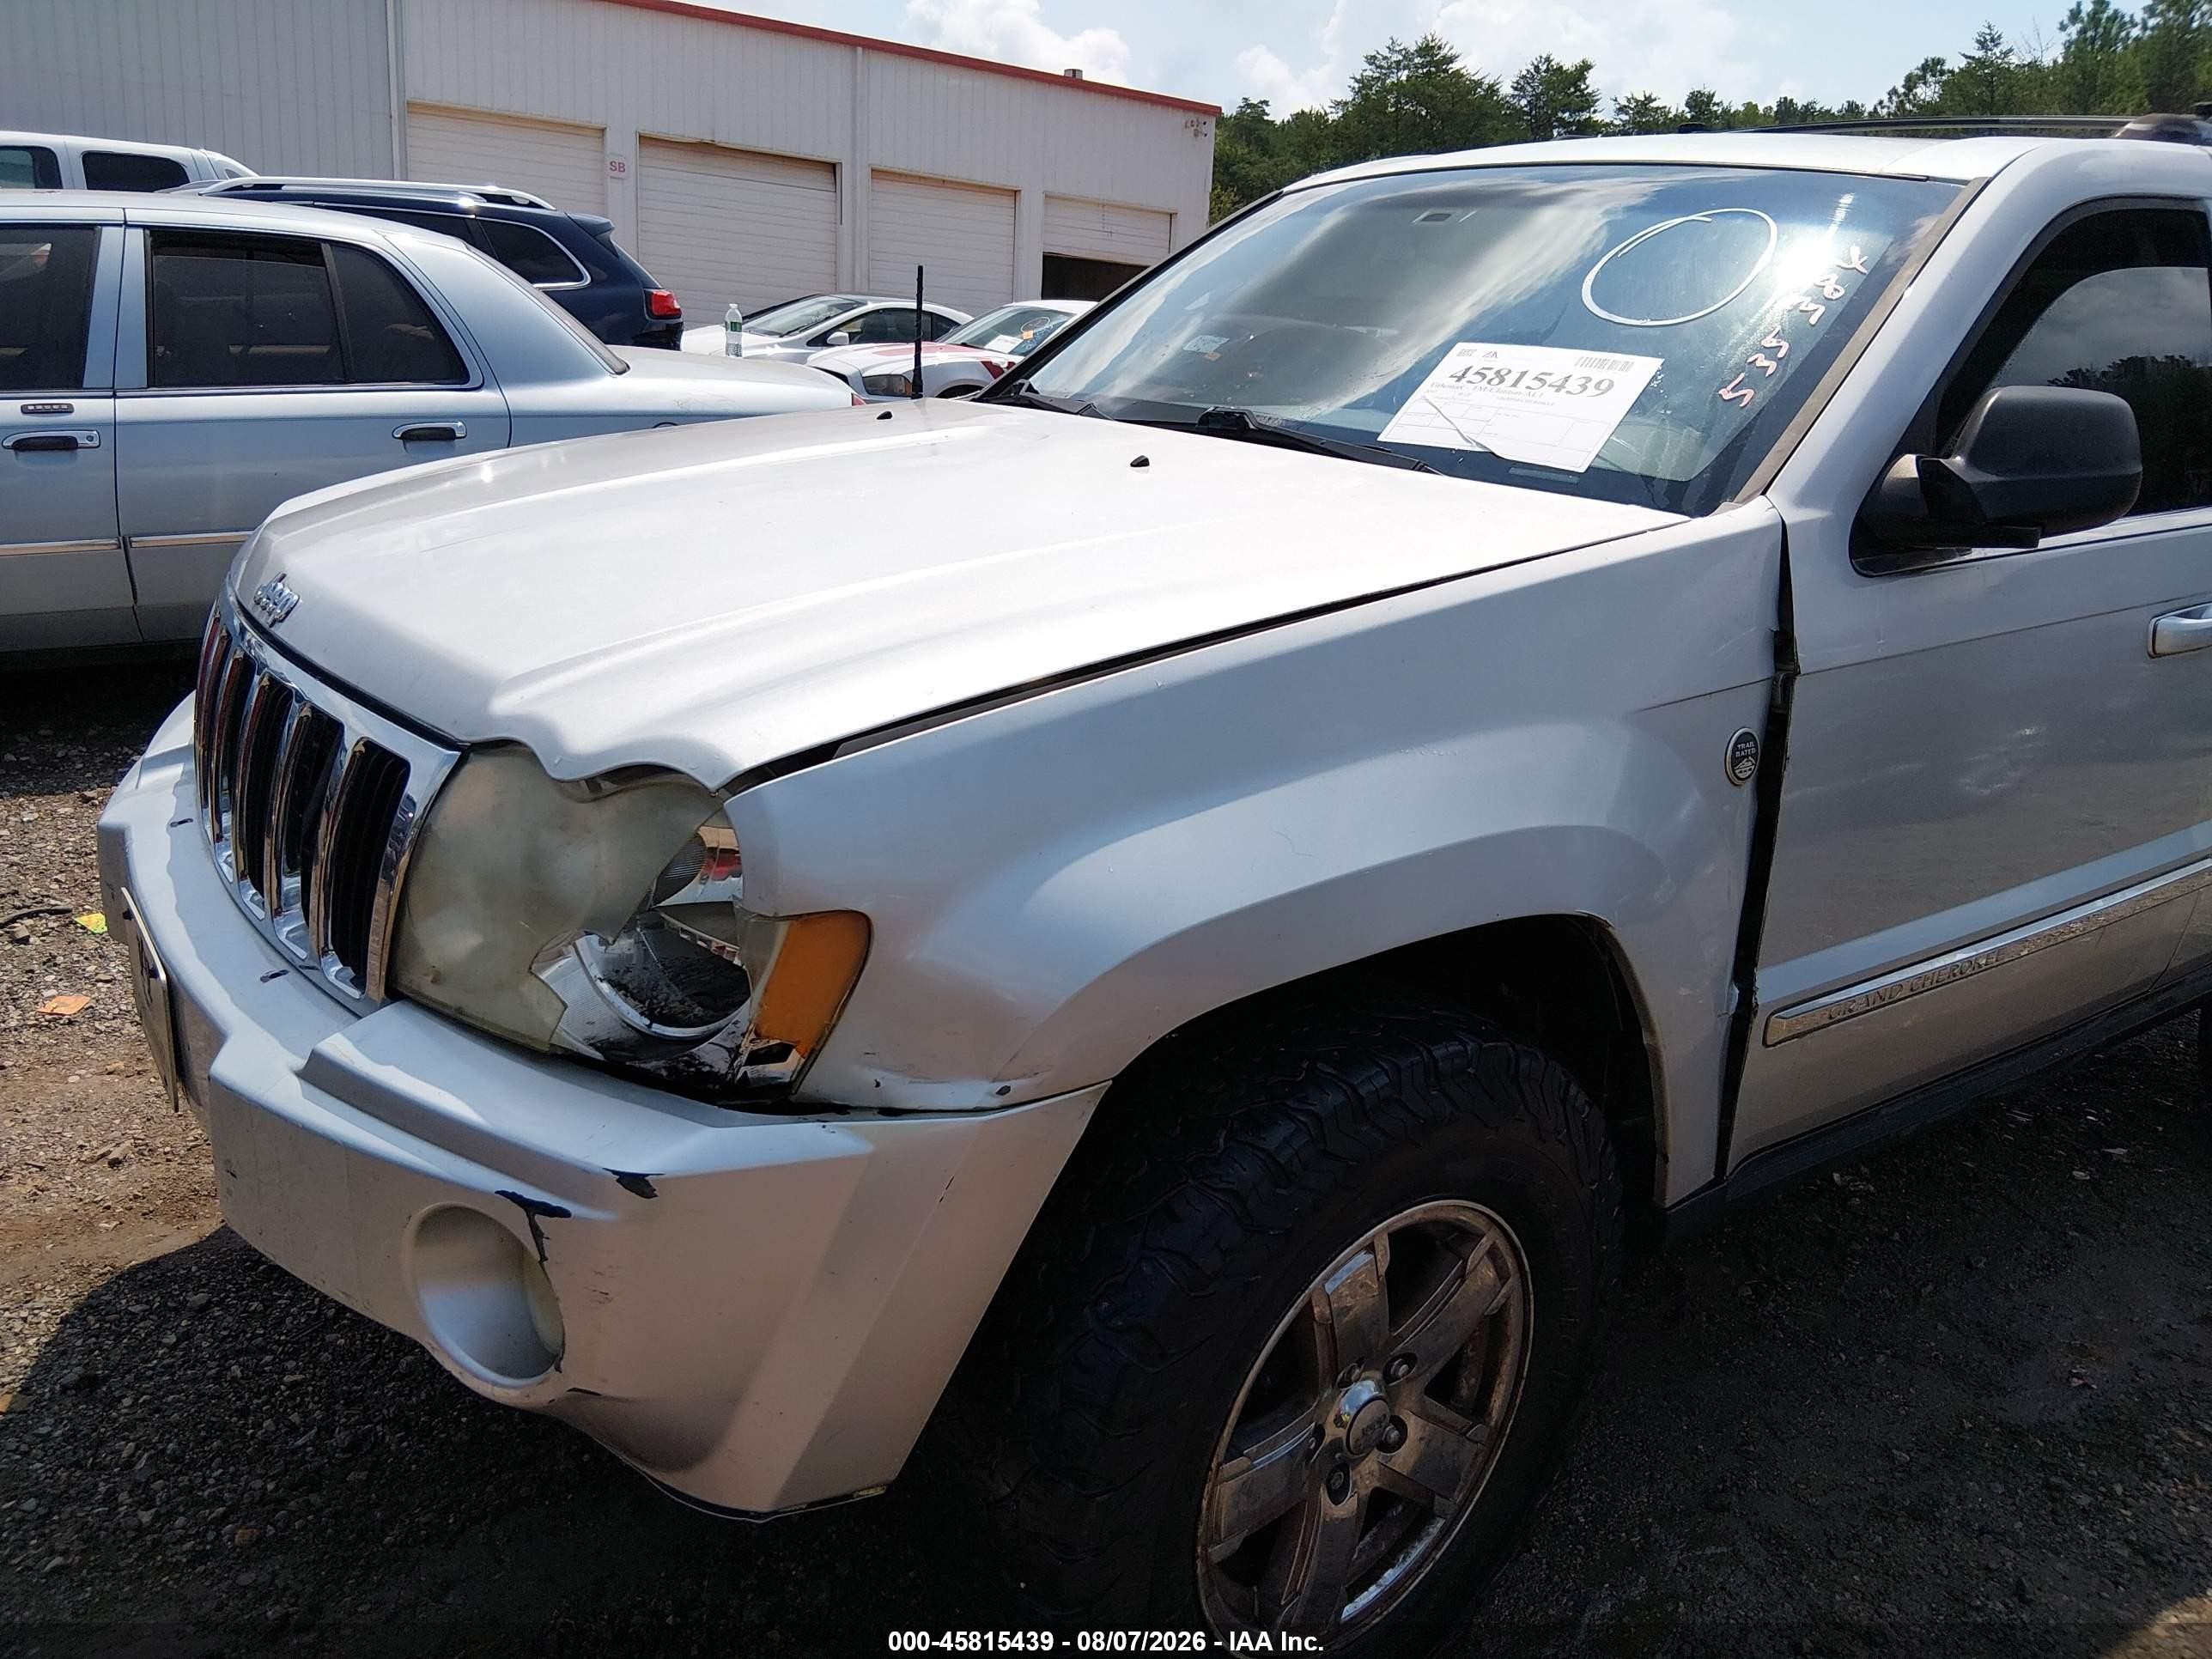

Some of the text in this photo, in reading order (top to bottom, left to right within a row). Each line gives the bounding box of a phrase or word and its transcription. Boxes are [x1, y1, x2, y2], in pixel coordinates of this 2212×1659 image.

[609, 161, 626, 173] SB
[1449, 365, 1614, 398] 45815439
[1737, 741, 1755, 750] TRAIL
[1735, 748, 1756, 757] RATED
[1828, 949, 2006, 1021] GRAND CHEROKEE
